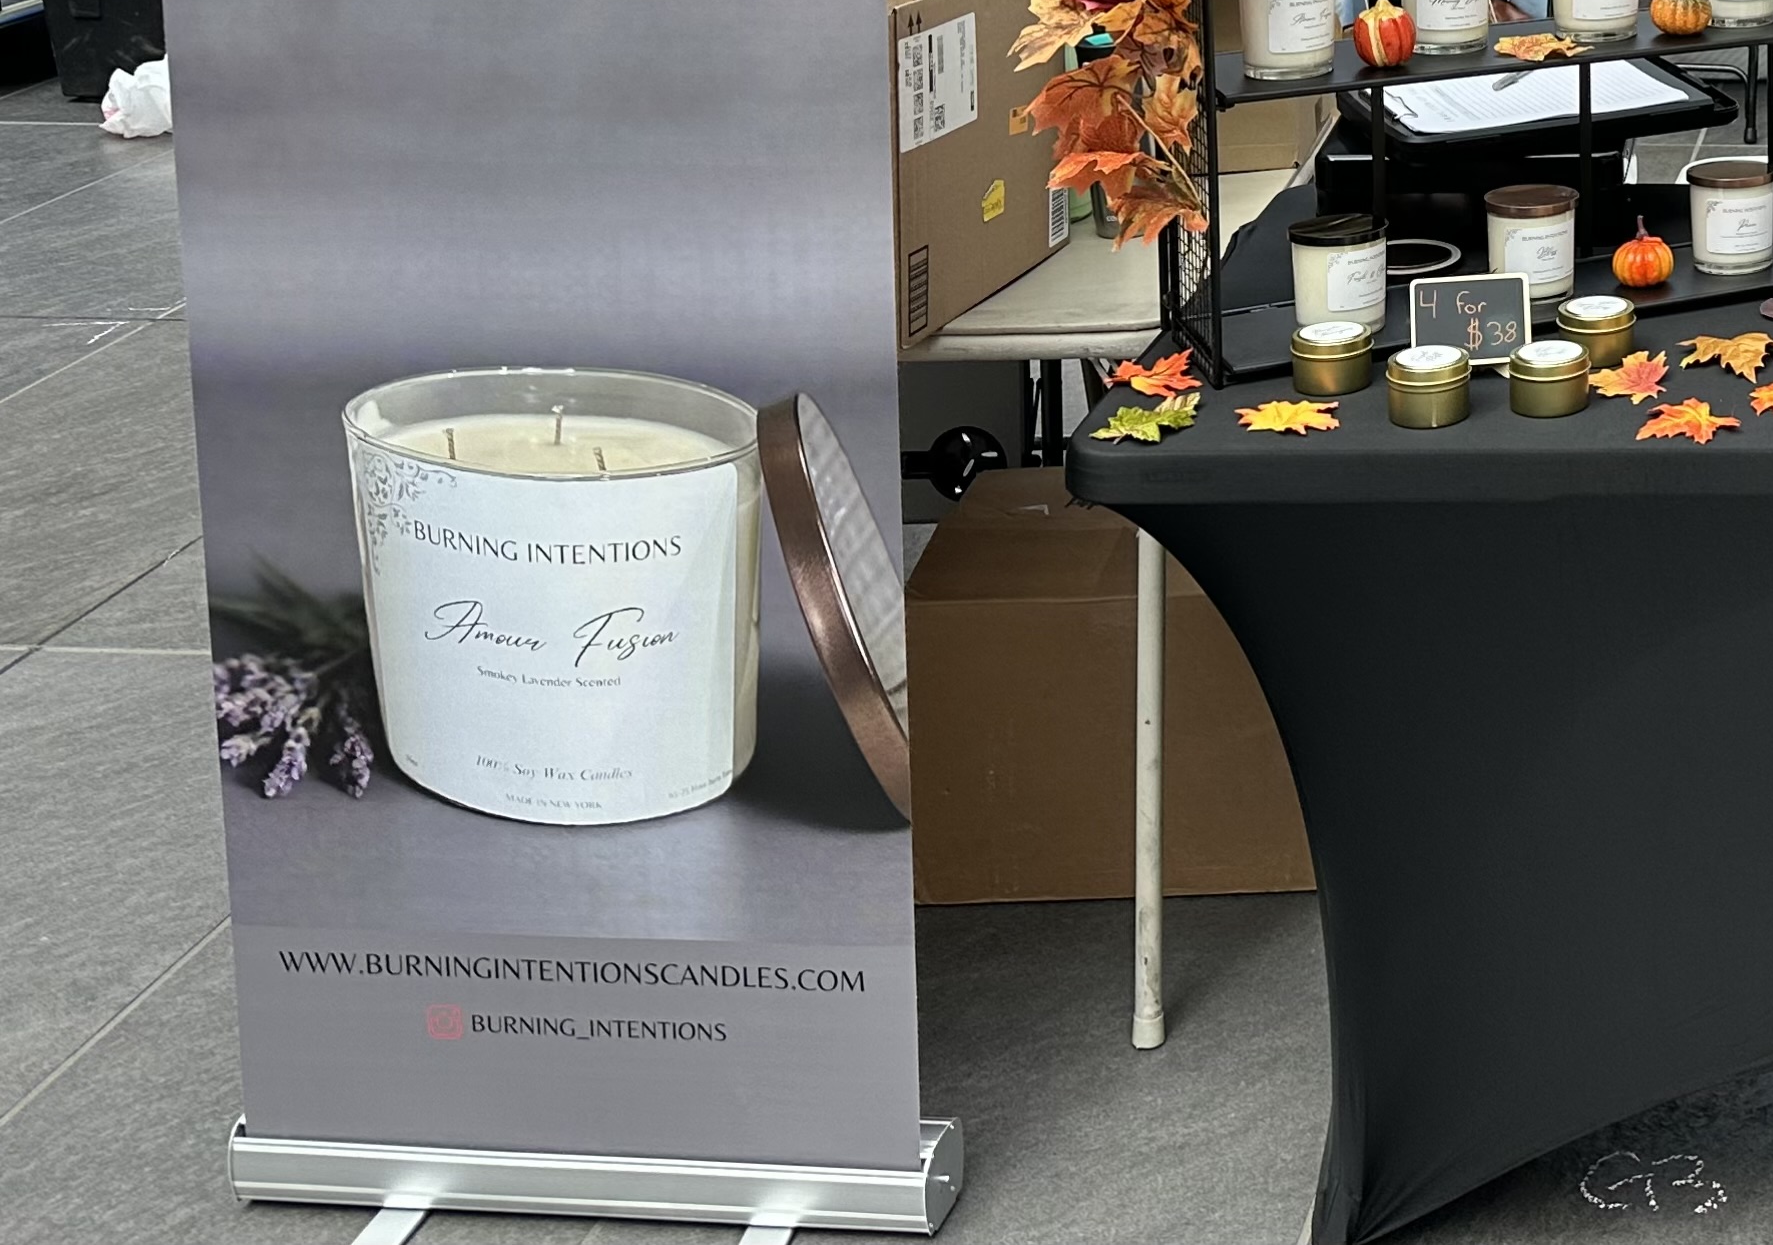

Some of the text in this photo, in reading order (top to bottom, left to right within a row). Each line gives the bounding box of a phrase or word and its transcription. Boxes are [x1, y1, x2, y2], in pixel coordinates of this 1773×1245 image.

[1419, 289, 1438, 319] 4
[1464, 317, 1518, 351] $38
[414, 519, 683, 565] BURNING INTENTIONS
[424, 599, 681, 668] Amour Fusion
[477, 665, 622, 688] Smokey Lavender Scented
[514, 763, 537, 779] Soy
[543, 767, 575, 782] Wax
[580, 767, 633, 782] Candles
[505, 793, 532, 806] MADE
[549, 800, 571, 809] NEW
[575, 800, 603, 810] YORK
[278, 950, 867, 994] WWW.BURNINGINTENTIONSCANDLES.COM
[471, 1014, 728, 1044] BURNING_INTENTIONS
